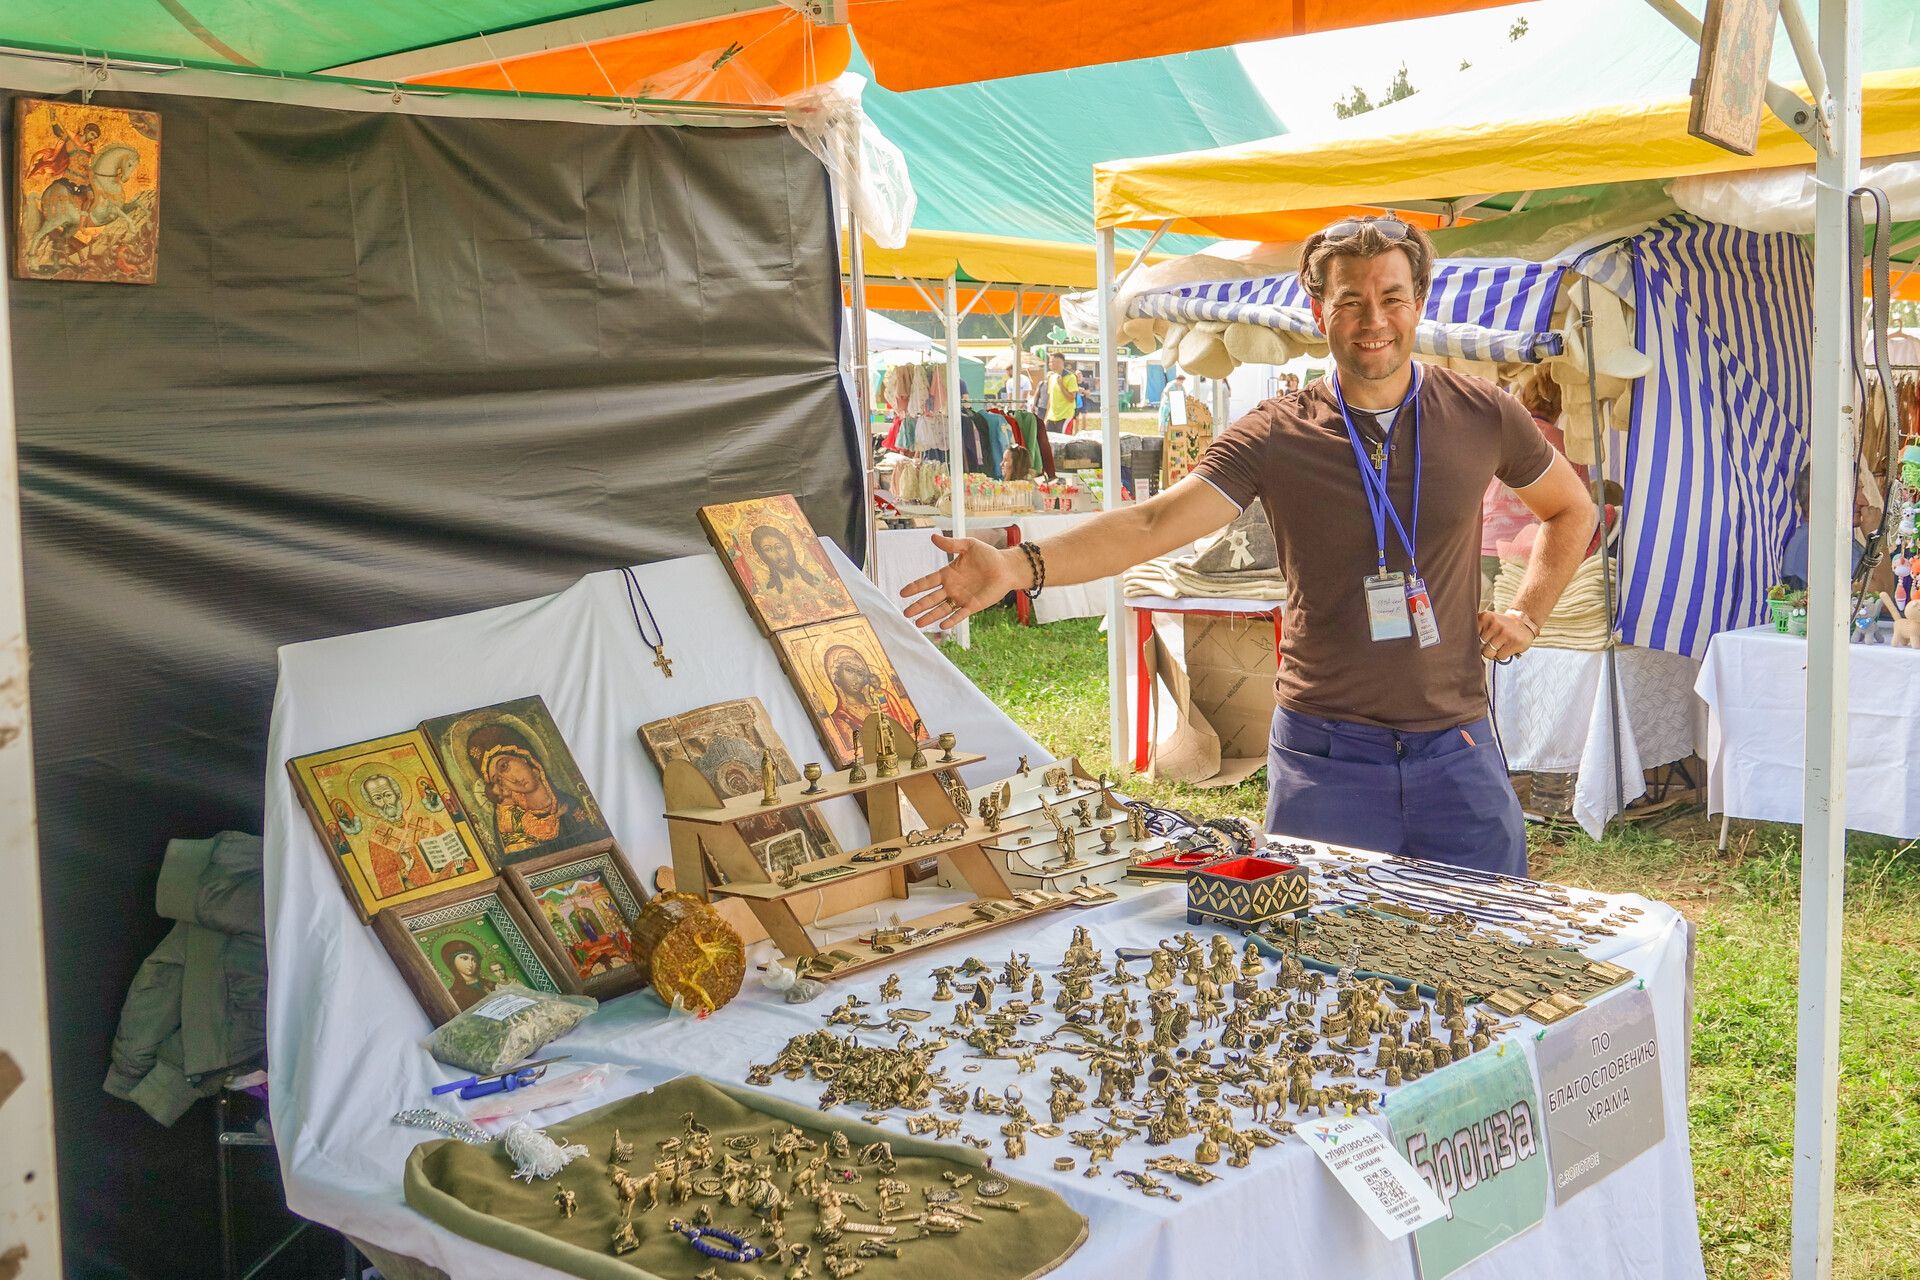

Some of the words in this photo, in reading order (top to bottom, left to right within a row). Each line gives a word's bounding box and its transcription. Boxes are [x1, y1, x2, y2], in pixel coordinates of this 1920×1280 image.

[1591, 1031, 1610, 1056] ПО
[1548, 1039, 1656, 1113] БЛАГОСЛОВЕНИЮ
[1587, 1087, 1630, 1126] ХРАМА
[1406, 1100, 1536, 1221] Бронза
